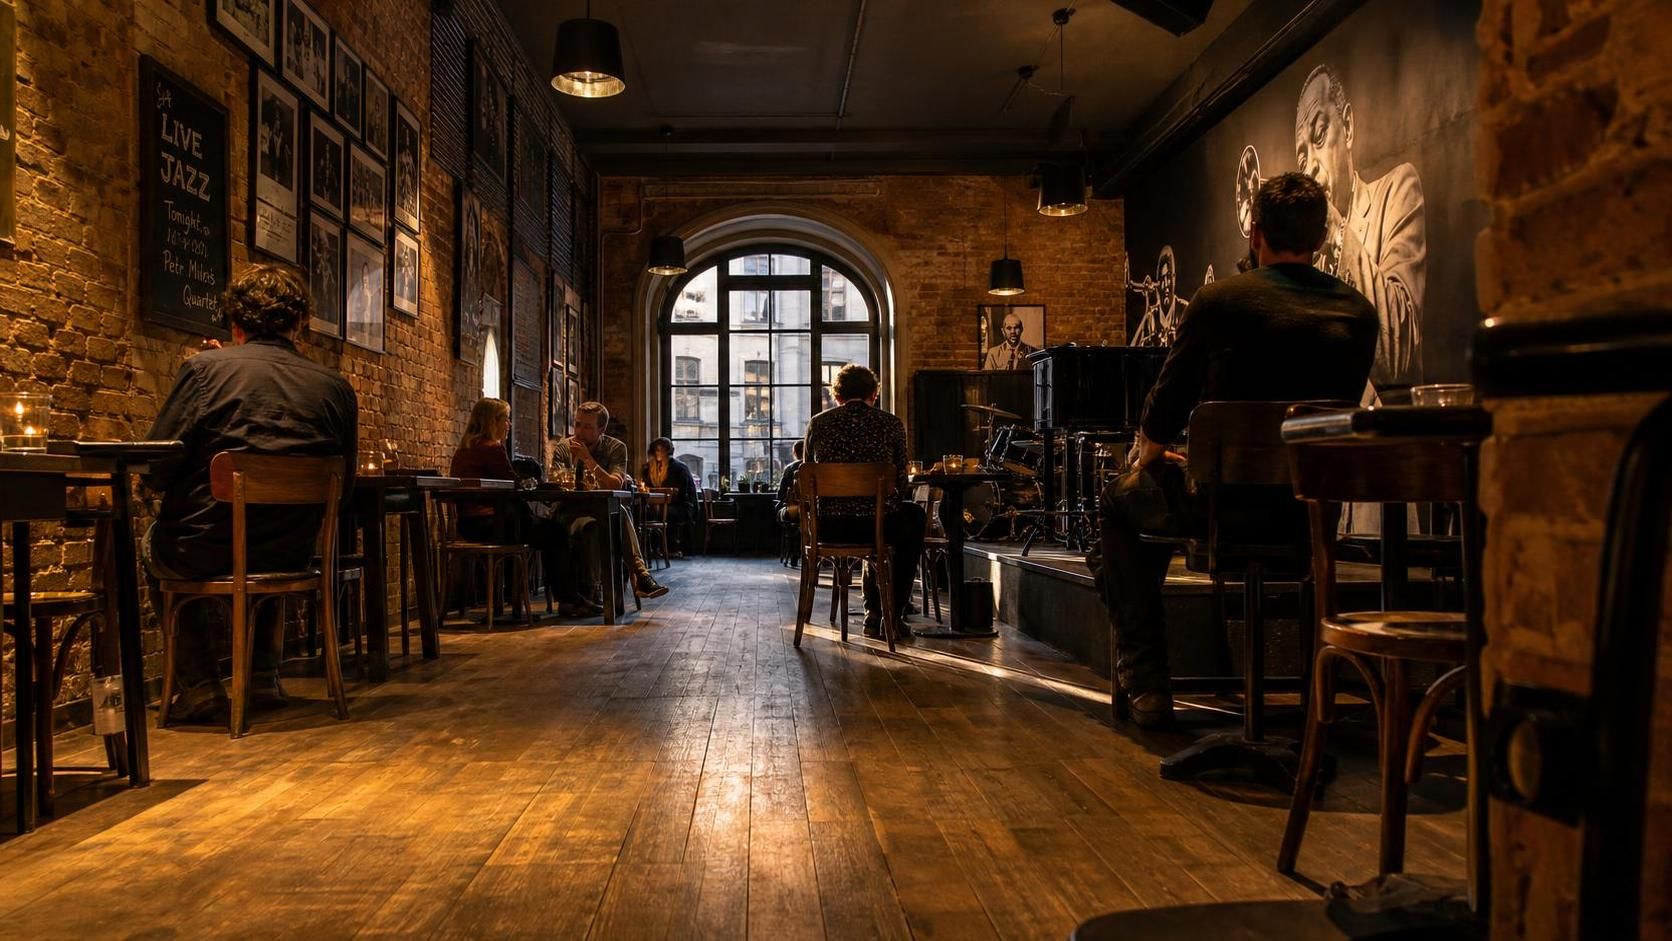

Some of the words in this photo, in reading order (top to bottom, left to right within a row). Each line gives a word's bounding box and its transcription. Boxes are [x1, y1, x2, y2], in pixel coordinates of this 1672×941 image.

[161, 113, 203, 159] LIVE
[161, 151, 210, 202] JAZZ
[163, 249, 184, 275] Petr
